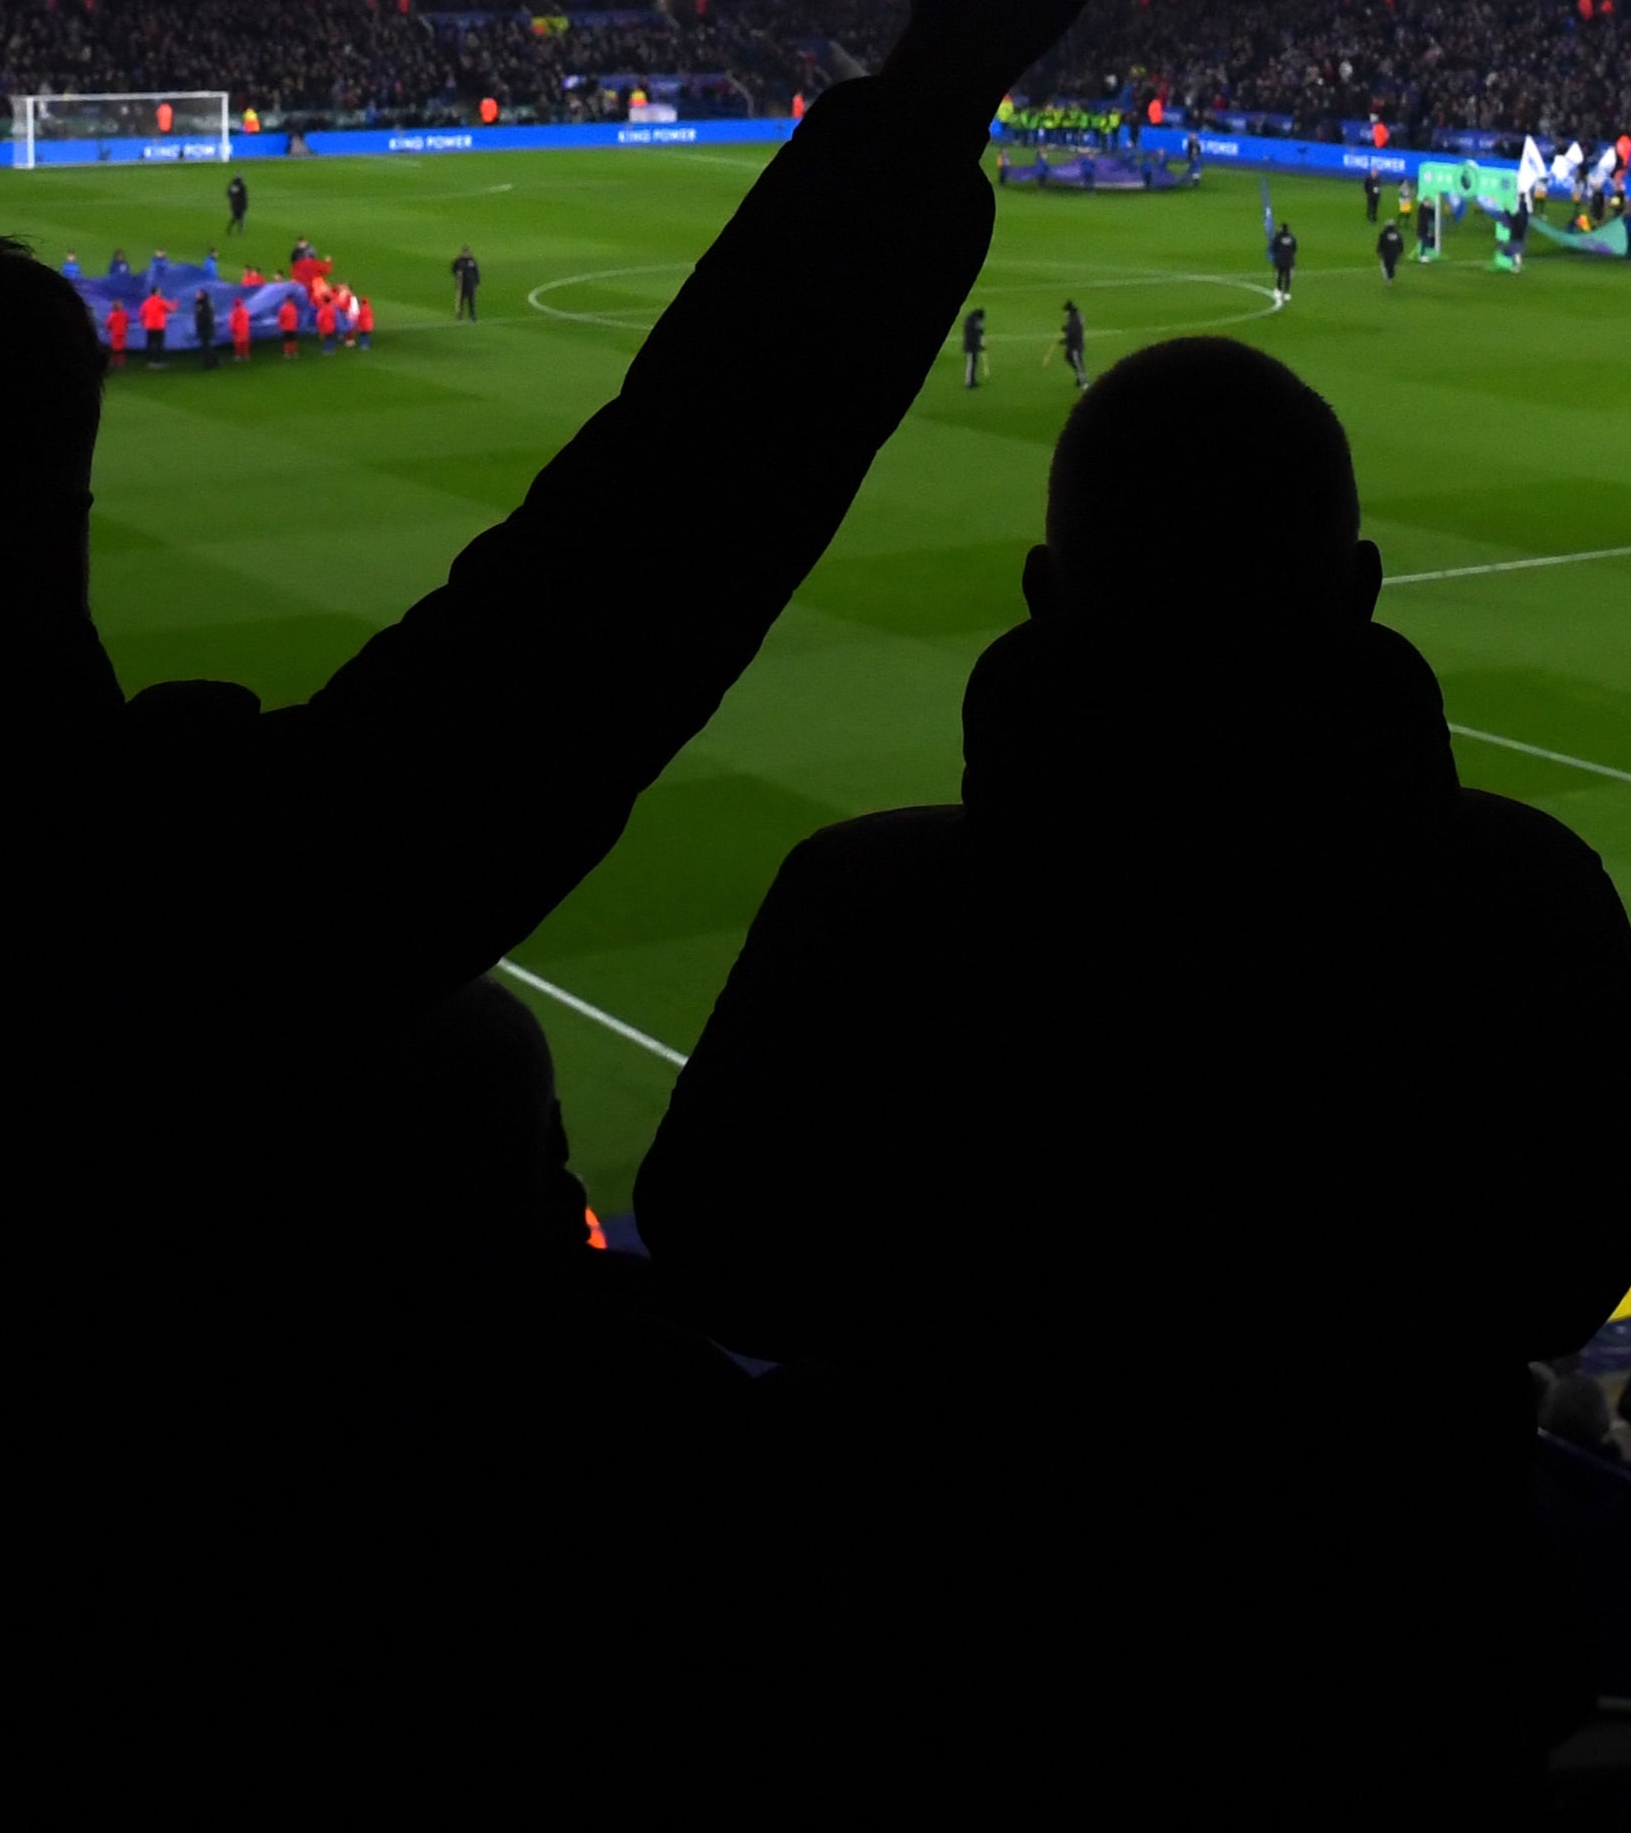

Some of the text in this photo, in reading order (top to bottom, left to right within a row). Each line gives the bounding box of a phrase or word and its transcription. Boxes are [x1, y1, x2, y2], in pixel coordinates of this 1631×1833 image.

[389, 135, 472, 150] KING POWER
[618, 128, 696, 143] KING POWER
[1370, 156, 1405, 172] POWER
